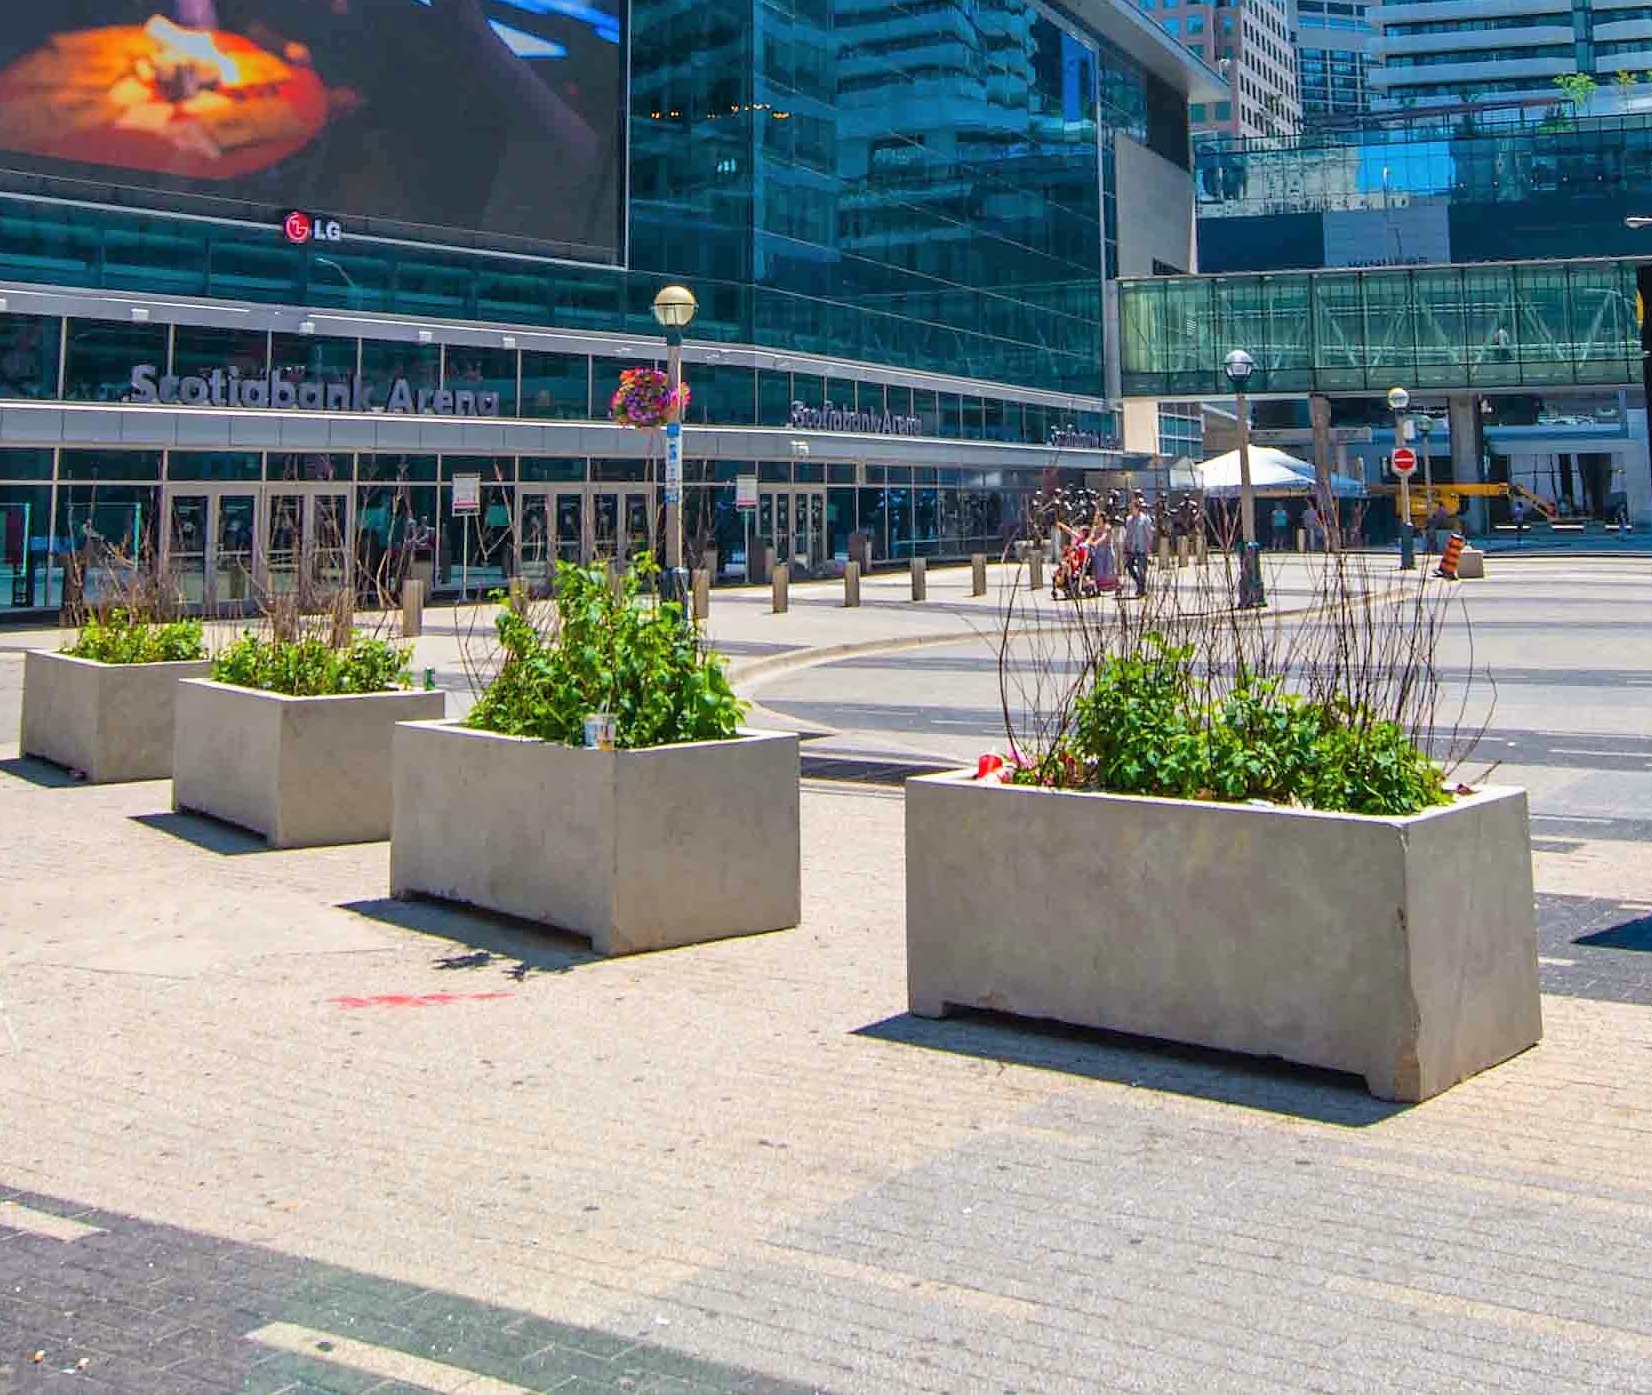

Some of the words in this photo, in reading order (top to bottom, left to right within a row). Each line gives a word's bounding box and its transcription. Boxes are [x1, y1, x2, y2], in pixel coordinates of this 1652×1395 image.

[313, 219, 341, 241] LG
[130, 363, 377, 414] Scotiabank
[386, 378, 499, 417] Arena
